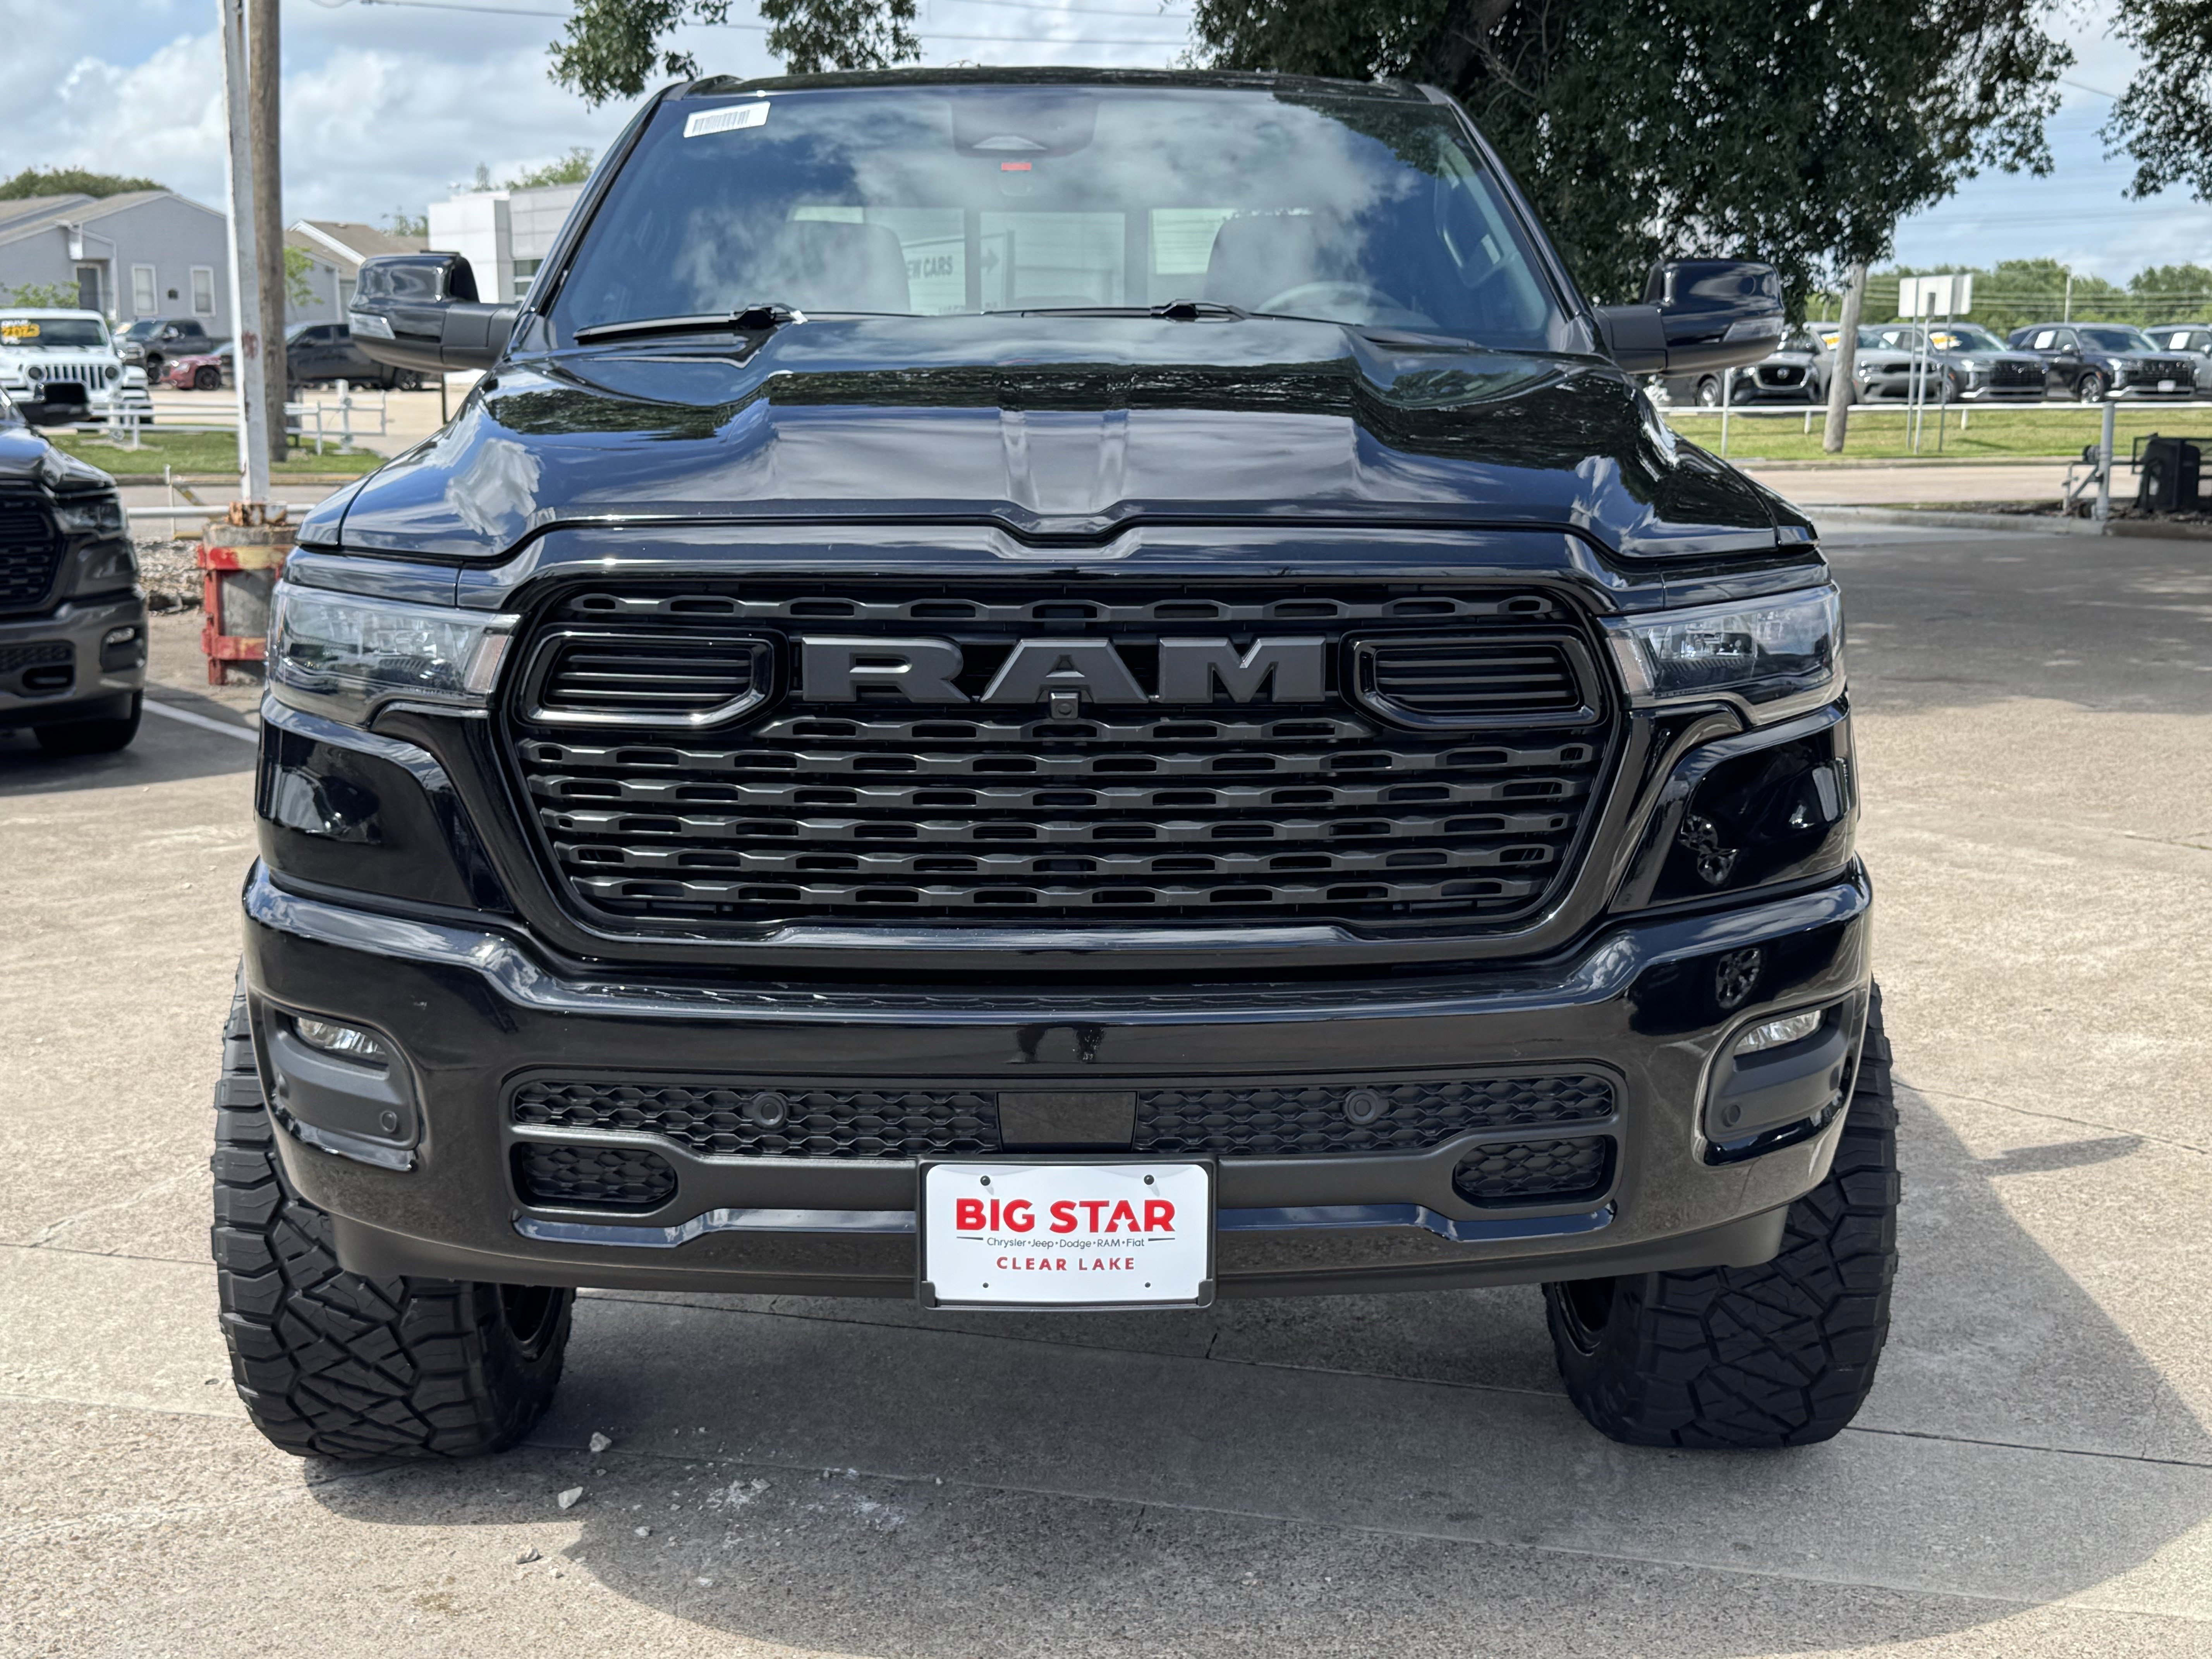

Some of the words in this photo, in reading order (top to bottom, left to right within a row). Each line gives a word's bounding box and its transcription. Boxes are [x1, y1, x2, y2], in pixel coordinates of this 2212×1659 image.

[802, 636, 1326, 704] RAM
[956, 1198, 1035, 1233] BIG
[1049, 1200, 1175, 1233] STAR
[996, 1257, 1067, 1271] CLEAR
[1079, 1257, 1135, 1270] LAKE
